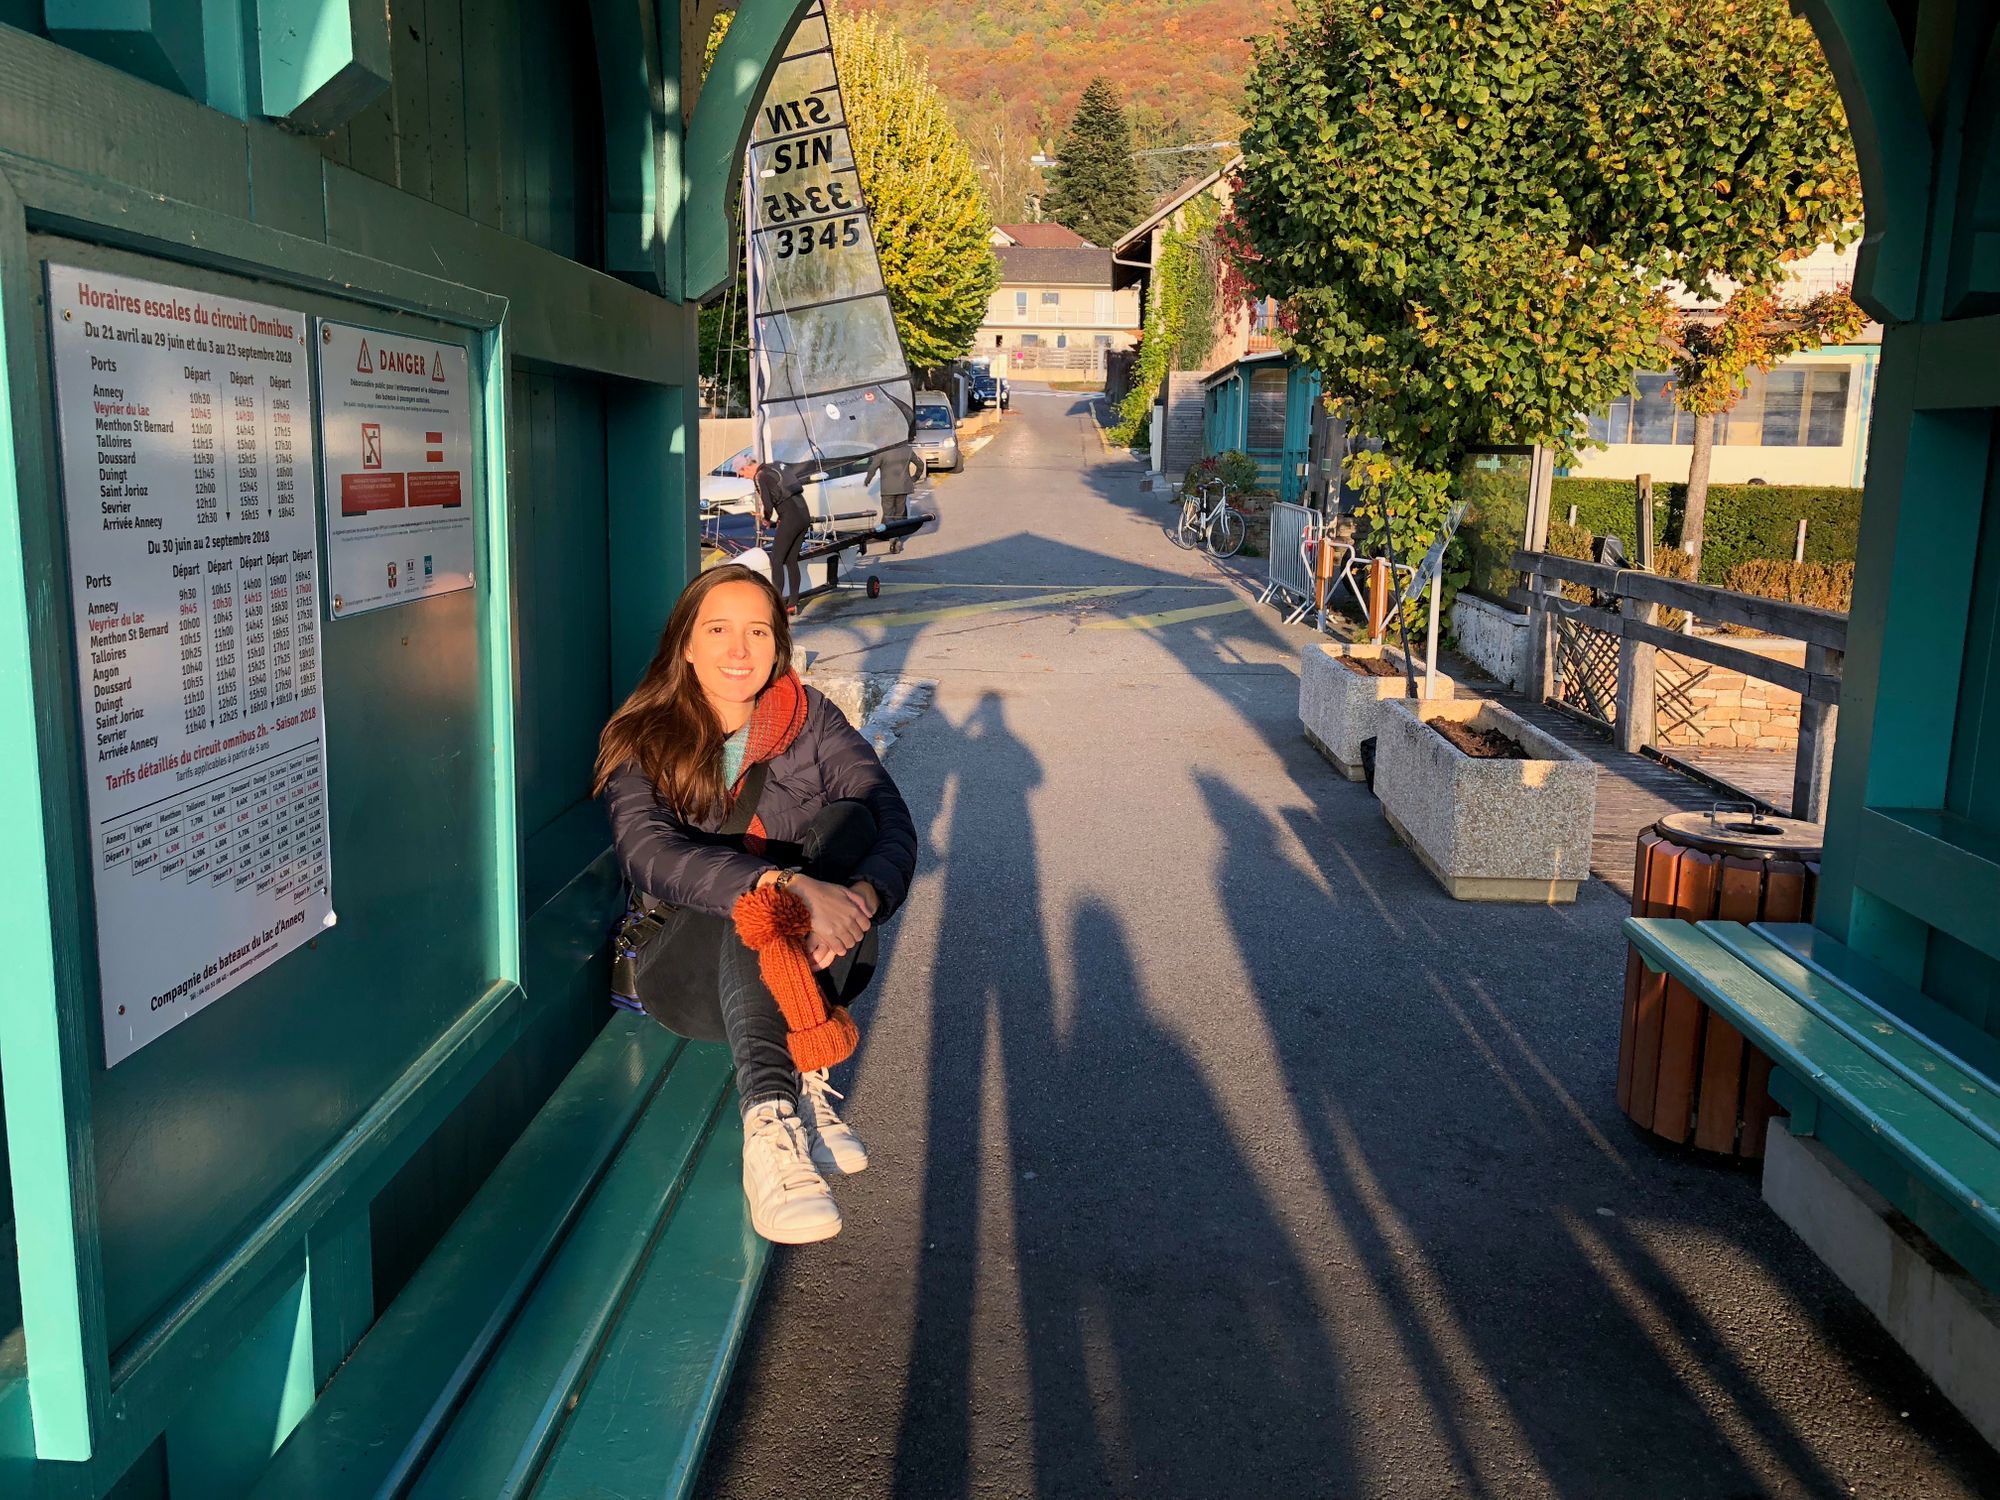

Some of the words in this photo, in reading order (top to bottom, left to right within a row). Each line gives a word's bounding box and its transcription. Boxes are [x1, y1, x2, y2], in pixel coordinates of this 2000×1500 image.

[775, 135, 833, 174] SIN
[777, 218, 860, 259] 3345
[78, 282, 141, 314] Horaires
[144, 298, 191, 322] escales
[193, 303, 208, 324] du
[211, 307, 247, 331] circuit
[249, 314, 293, 339] Omnibus
[84, 321, 99, 337] Du
[101, 324, 114, 340] 21
[116, 327, 139, 343] avril
[140, 333, 152, 344] au
[154, 332, 165, 346] 29
[167, 332, 184, 350] juin
[186, 337, 195, 350] et
[196, 337, 207, 352] du
[215, 343, 225, 354] au
[226, 342, 236, 356] 23
[237, 346, 274, 361] septembre
[275, 349, 292, 363] 2018
[90, 355, 116, 372] Ports
[183, 365, 211, 382] Départ
[229, 370, 254, 386] Départ
[269, 375, 291, 389] Départ
[380, 349, 426, 376] DANGER
[93, 383, 123, 400] Annecy
[189, 391, 210, 404] 10h30
[93, 400, 124, 415] Veyrier
[125, 402, 136, 415] du
[136, 402, 149, 416] lac
[190, 406, 211, 419] 10h45
[95, 417, 132, 431] Menthon
[133, 419, 142, 432] St
[143, 419, 173, 432] Bernard
[191, 422, 212, 434] 11h00
[95, 434, 131, 447] Talloires
[192, 437, 213, 449] 11h15
[97, 451, 136, 464] Doussard
[193, 452, 214, 464] 11h30
[99, 467, 127, 482] Duingt
[194, 467, 215, 479] 11h45
[100, 484, 122, 497] Saint
[124, 483, 148, 496] Jorioz
[195, 481, 215, 494] 12h00
[101, 500, 131, 513] Sevrier
[195, 497, 216, 509] 12h10
[102, 516, 133, 530] Arrivée
[134, 515, 162, 529] Annecy
[196, 511, 217, 524] 12h30
[147, 539, 160, 554] Du
[162, 539, 173, 552] 30
[174, 536, 191, 555] juin
[193, 539, 203, 549] au
[211, 531, 251, 549] septembre
[252, 530, 269, 543] 2018
[85, 574, 111, 589] Ports
[172, 562, 200, 579] Départ
[207, 558, 232, 575] Départ
[239, 555, 263, 570] Départ
[266, 551, 288, 566] Départ
[292, 548, 312, 563] Départ
[87, 601, 118, 615] Annecy
[178, 587, 196, 600] 9h30
[211, 582, 231, 595] 10h15
[88, 615, 119, 632] Veyrier
[120, 613, 131, 626] du
[132, 611, 144, 623] lac
[179, 602, 197, 615] 9h45
[212, 595, 232, 609] 10h30
[90, 631, 126, 648] Menthon
[128, 628, 137, 640] St
[138, 621, 168, 639] Bernard
[178, 616, 200, 631] 10h00
[213, 610, 232, 624] 10h45
[90, 648, 126, 664] Talloires
[179, 631, 201, 645] 10h15
[214, 624, 233, 638] 11h00
[92, 666, 119, 681] Angon
[180, 645, 201, 660] 10h25
[214, 638, 234, 652] 11h10
[93, 676, 131, 697] Doussard
[181, 660, 202, 675] 10h40
[215, 652, 235, 667] 11h25
[94, 695, 123, 713] Duingt
[182, 675, 203, 690] 10h55
[216, 666, 236, 681] 11h40
[95, 713, 118, 730] Saint
[119, 707, 144, 723] Jorioz
[183, 689, 204, 705] 11h10
[217, 680, 236, 695] 11h55
[97, 728, 126, 746] Sevrier
[184, 704, 205, 720] 11h20
[218, 694, 237, 710] 12h05
[98, 742, 128, 762] Arrivée
[129, 735, 158, 752] Annecy
[185, 718, 206, 734] 11h40
[219, 708, 238, 724] 12h25
[105, 767, 135, 791] Tarifs
[137, 753, 178, 780] détaillés
[180, 749, 191, 764] du
[193, 739, 221, 760] circuit
[222, 729, 255, 750] omnibus
[256, 722, 268, 737] 2h.
[275, 714, 298, 731] Saison
[299, 706, 316, 723] 2018
[175, 766, 193, 781] Tarifs
[193, 756, 226, 776] applicables
[232, 748, 247, 764] partir
[248, 745, 254, 755] de
[260, 740, 269, 751] ans
[150, 972, 201, 1011] Compagnie
[202, 962, 217, 980] des
[218, 942, 250, 970] bateaux
[251, 935, 261, 950] du
[261, 928, 273, 943] lac
[274, 909, 304, 935] d'Annecy
